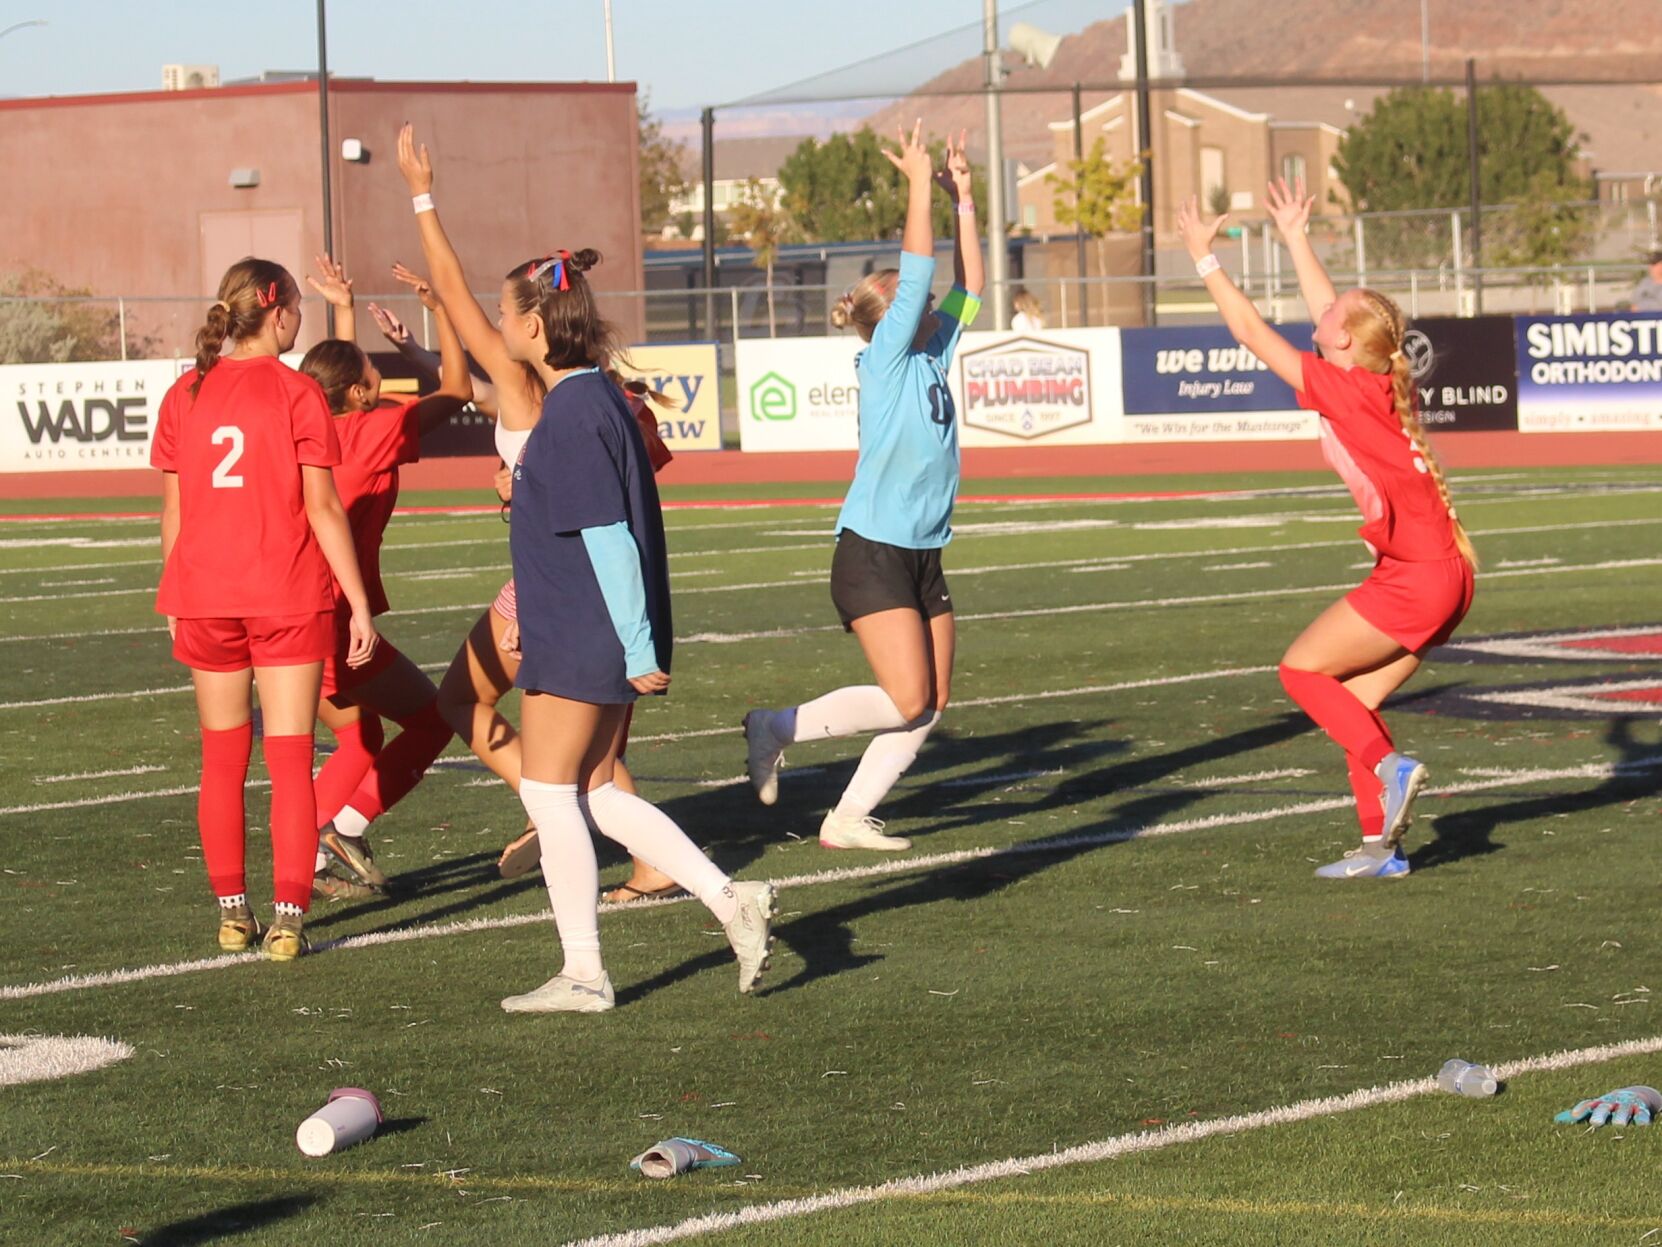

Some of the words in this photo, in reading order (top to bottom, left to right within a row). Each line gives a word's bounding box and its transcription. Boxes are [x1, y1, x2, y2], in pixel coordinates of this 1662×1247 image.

[1156, 349, 1202, 373] we
[1531, 360, 1662, 384] ORTHODON
[19, 379, 145, 395] STEPHEN
[967, 379, 1084, 408] PLUMBING
[1178, 380, 1222, 398] Injury
[1223, 379, 1254, 395] Law
[1441, 385, 1508, 406] BLIND
[17, 398, 148, 443] WADE
[24, 450, 67, 460] AUTO
[78, 448, 146, 458] CENTER
[211, 425, 244, 488] 2
